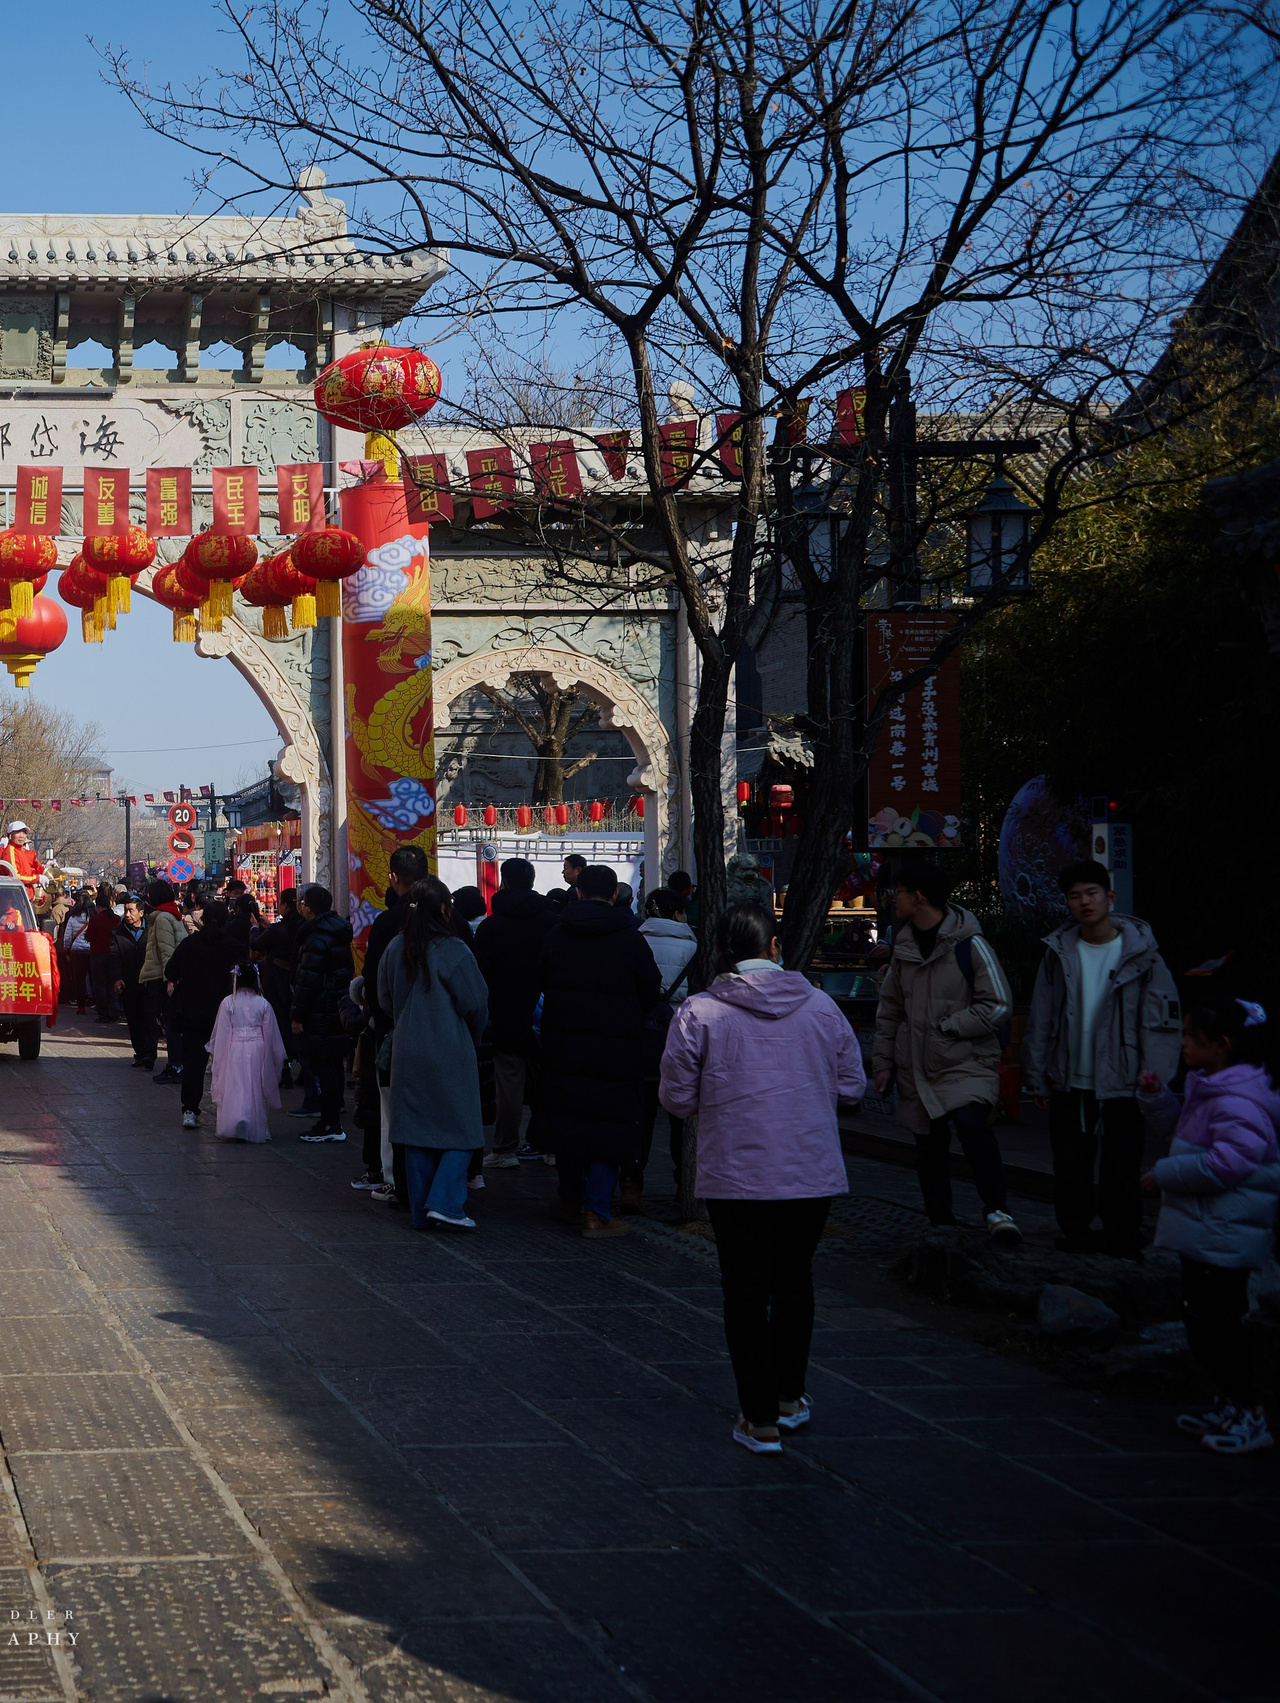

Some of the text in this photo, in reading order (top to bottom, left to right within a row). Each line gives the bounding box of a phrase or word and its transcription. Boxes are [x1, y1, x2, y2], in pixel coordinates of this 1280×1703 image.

[29, 476, 49, 525] 诚信
[97, 476, 115, 526] 友善
[160, 476, 178, 527] 富强
[226, 475, 245, 526] 民主
[291, 474, 311, 523] 文明
[175, 809, 190, 823] 20
